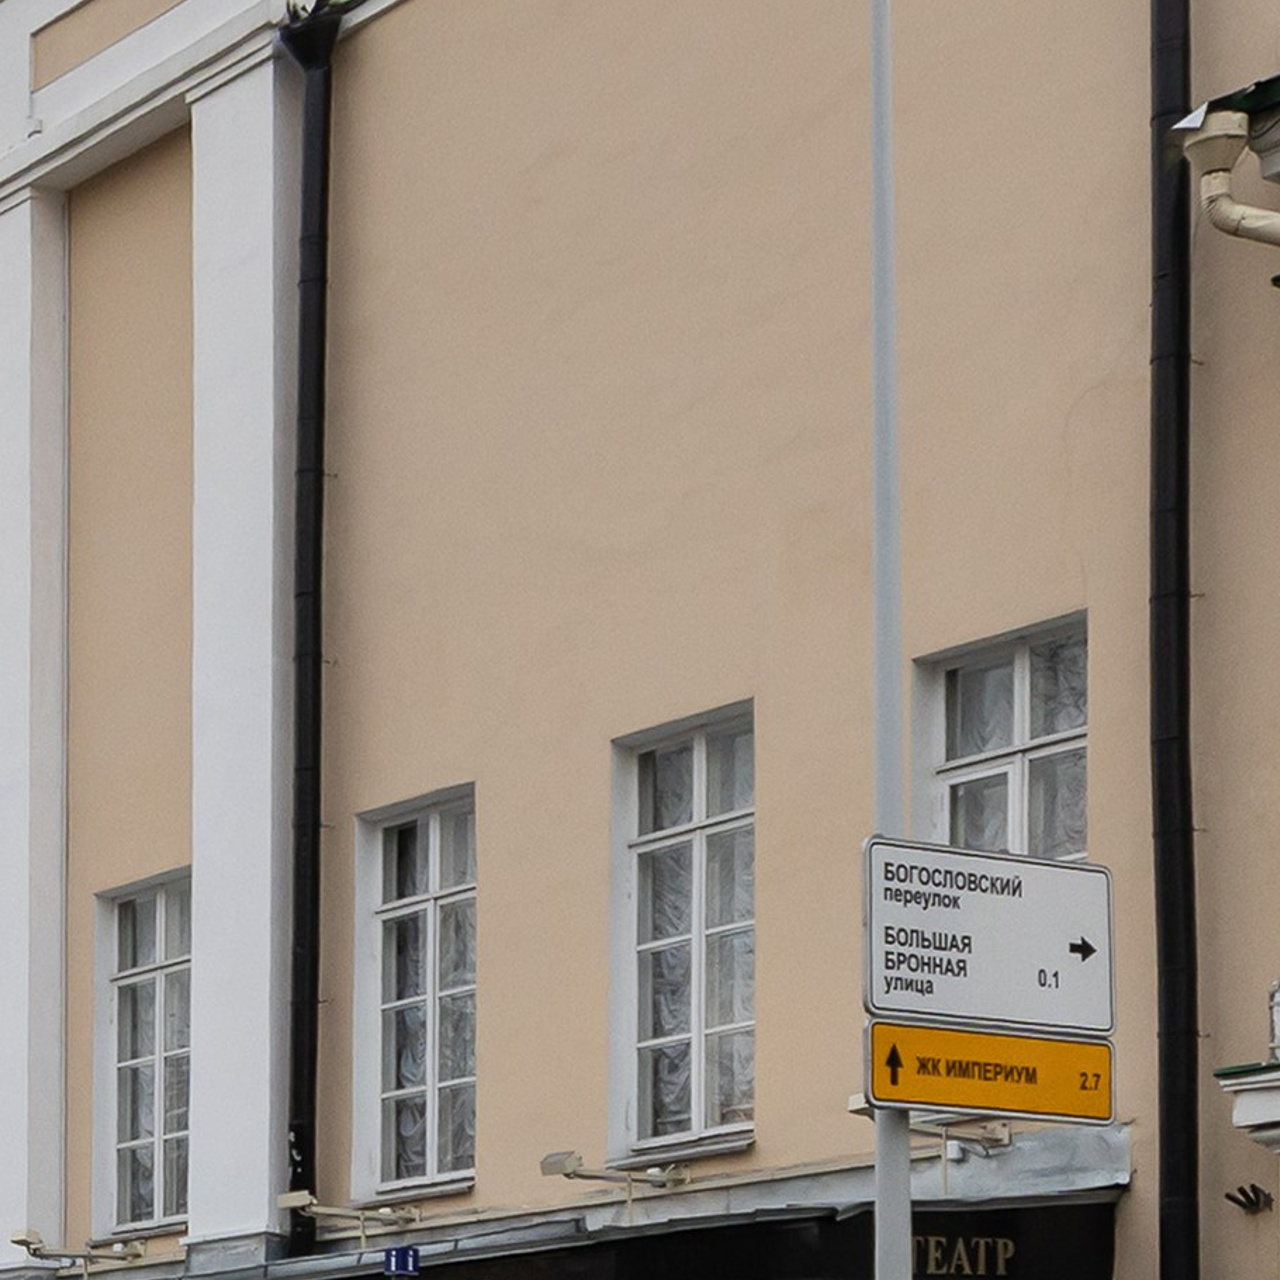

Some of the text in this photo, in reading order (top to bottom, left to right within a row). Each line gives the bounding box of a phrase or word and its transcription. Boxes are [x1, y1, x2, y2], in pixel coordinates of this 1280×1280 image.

[883, 862, 1023, 898] БОГОСЛОВСКИЙ
[883, 887, 961, 910] переулок
[884, 926, 972, 954] БОЛЬШАЯ
[884, 951, 968, 978] БРОННАЯ
[884, 969, 1060, 996] улица 0.1
[916, 1056, 1101, 1091] ЖК ИМПЕРИУМ 2.7
